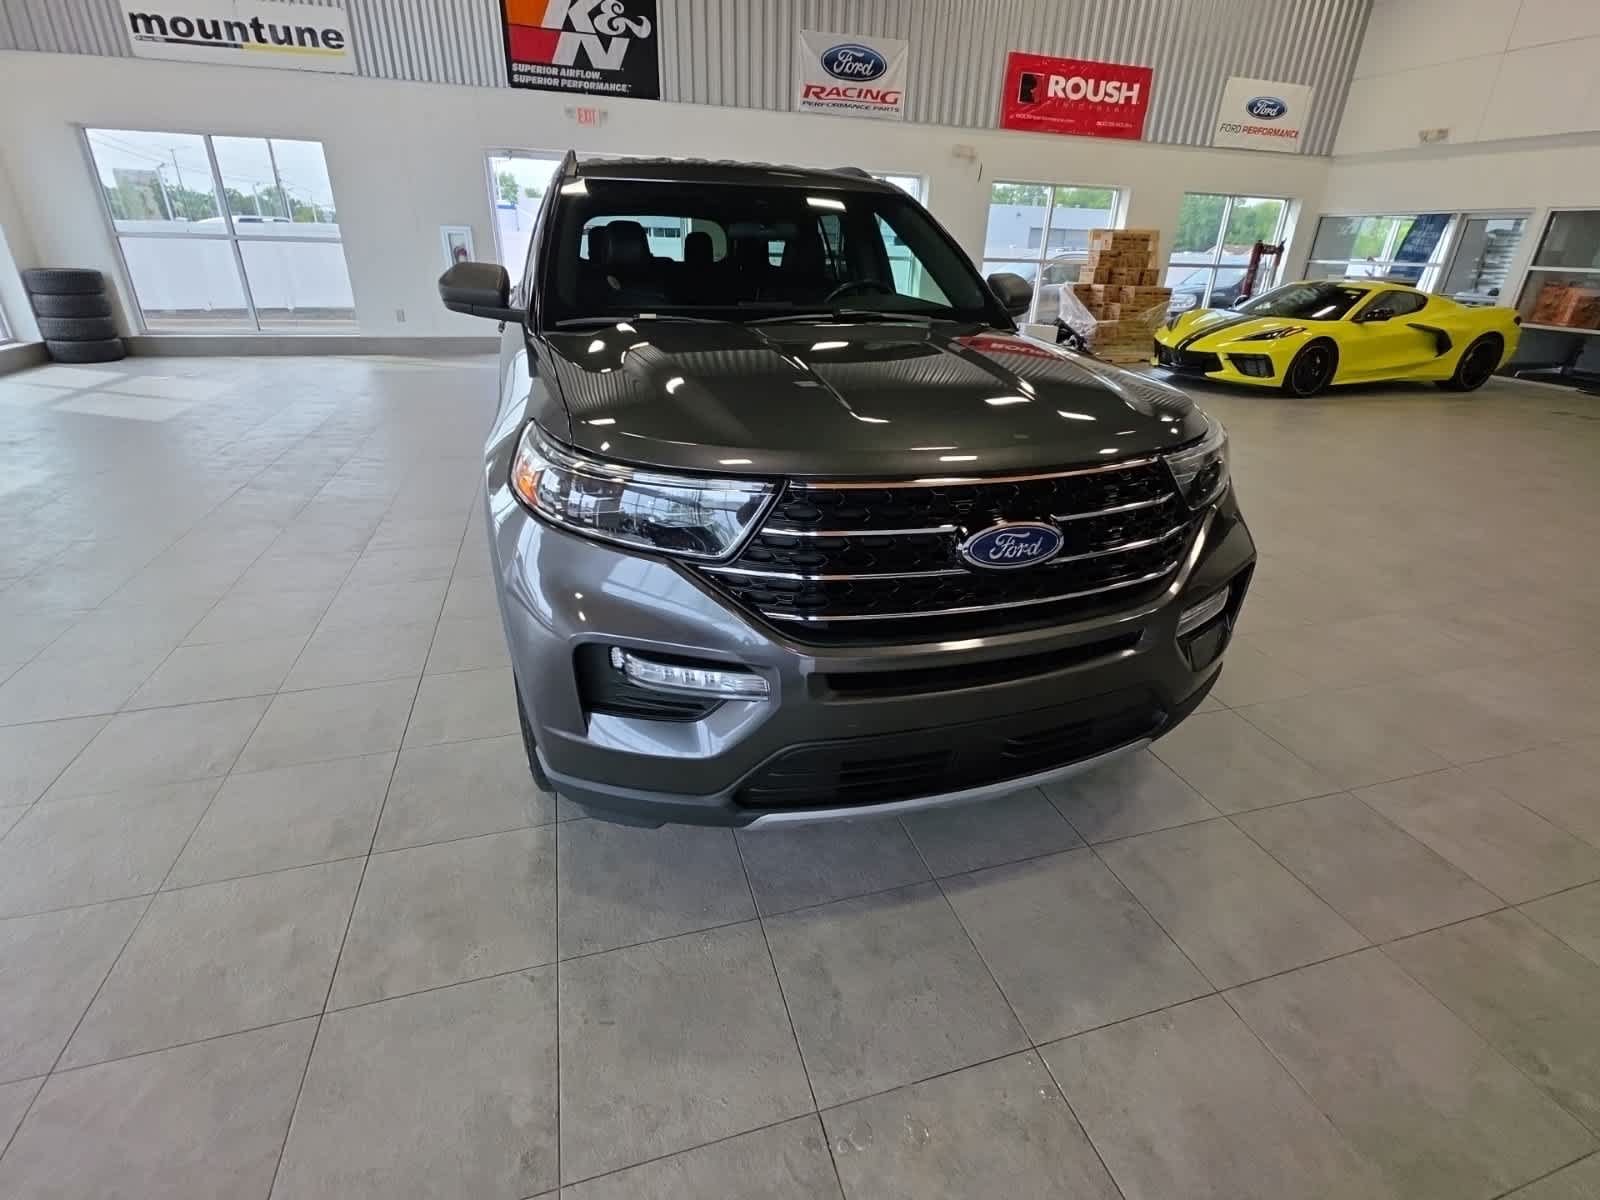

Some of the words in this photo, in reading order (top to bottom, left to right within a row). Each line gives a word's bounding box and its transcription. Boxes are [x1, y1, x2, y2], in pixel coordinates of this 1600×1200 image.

[128, 11, 345, 49] mountune
[512, 63, 559, 75] SUPERIOR
[560, 67, 602, 80] AIRFLOW.
[833, 49, 875, 76] Ford
[513, 74, 560, 86] SUPERIOR
[803, 84, 902, 105] RACING
[1047, 75, 1140, 105] ROUSH
[802, 101, 871, 111] PERFORMANCE
[872, 105, 899, 113] PARTS
[1253, 99, 1280, 116] Ford
[1220, 123, 1241, 134] FORD
[989, 532, 1044, 560] Ford
